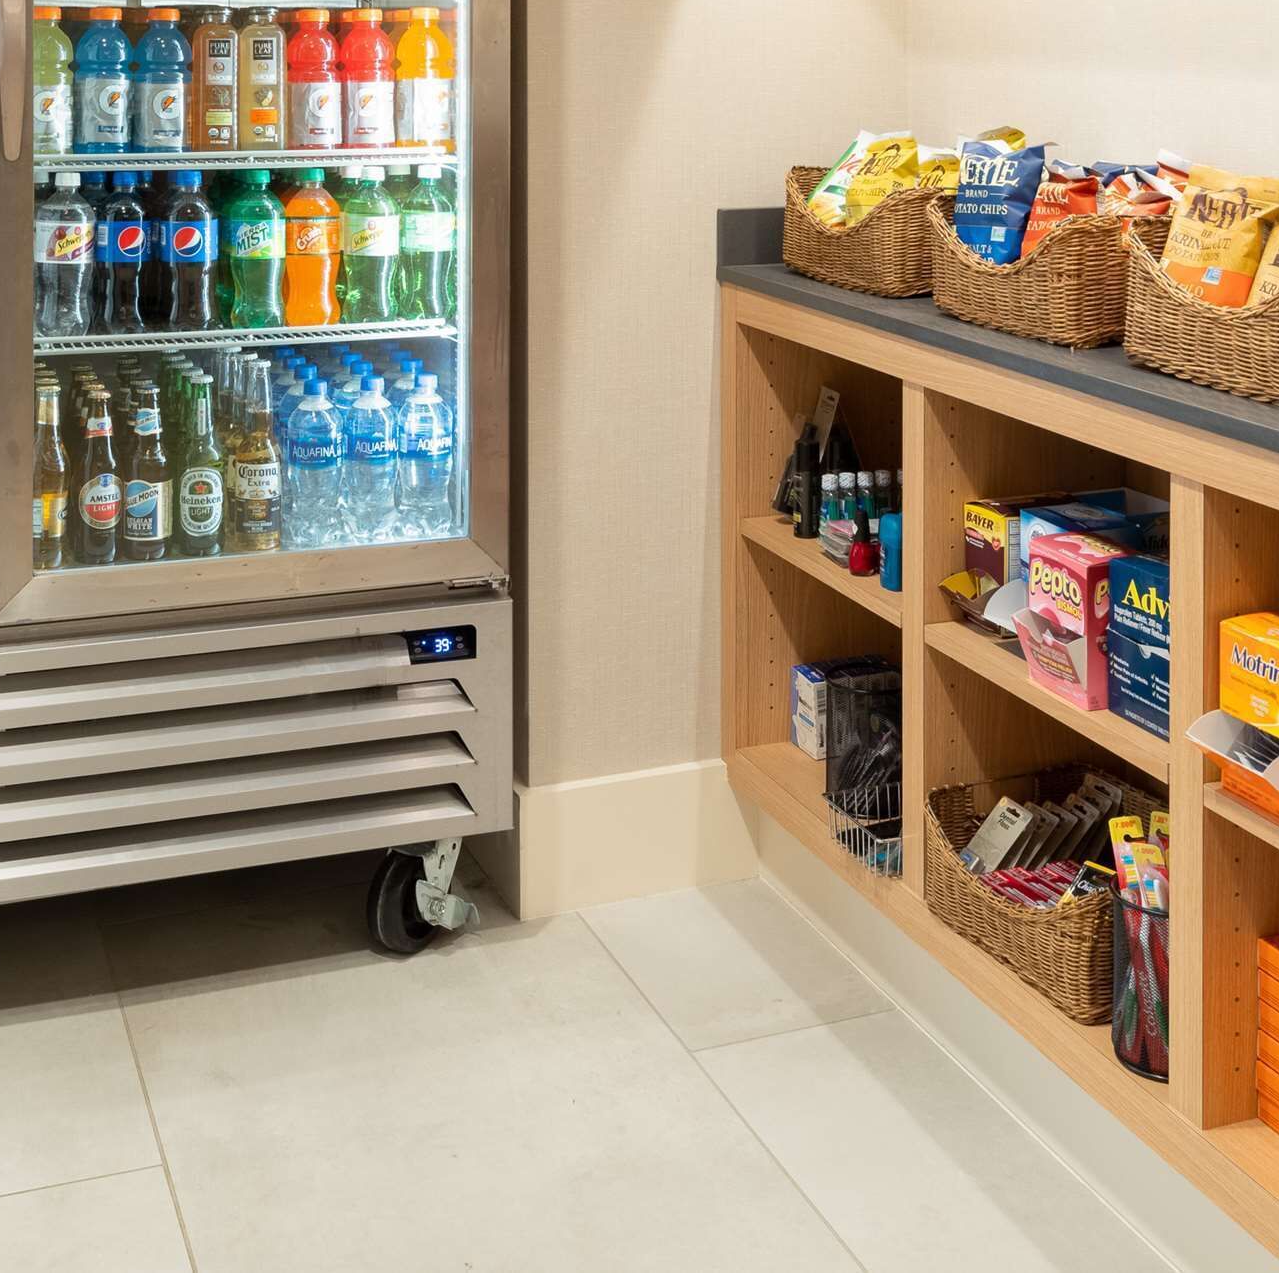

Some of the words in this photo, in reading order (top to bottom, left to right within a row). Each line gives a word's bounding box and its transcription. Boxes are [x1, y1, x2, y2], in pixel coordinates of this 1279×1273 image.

[210, 41, 229, 49] PURE
[254, 41, 273, 49] PURE
[210, 48, 229, 56] LEAF
[254, 48, 273, 56] LEAF
[965, 190, 988, 199] BRAND
[980, 204, 1008, 215] CHIPS
[1036, 206, 1061, 215] BRAND
[236, 228, 268, 252] MIST
[295, 226, 324, 251] Crush
[293, 445, 337, 459] AQUAFINA
[239, 464, 278, 479] Corona
[247, 479, 271, 488] Extra
[90, 492, 120, 503] AMSTEL
[138, 489, 160, 503] MOON
[181, 495, 222, 505] Heineken
[191, 508, 212, 516] LIGHT
[128, 522, 153, 530] WHITE
[966, 511, 995, 531] BAYER
[1030, 558, 1083, 606] Pepto
[1056, 599, 1083, 622] BISMOL
[434, 637, 450, 653] 39
[1000, 810, 1018, 826] Dental
